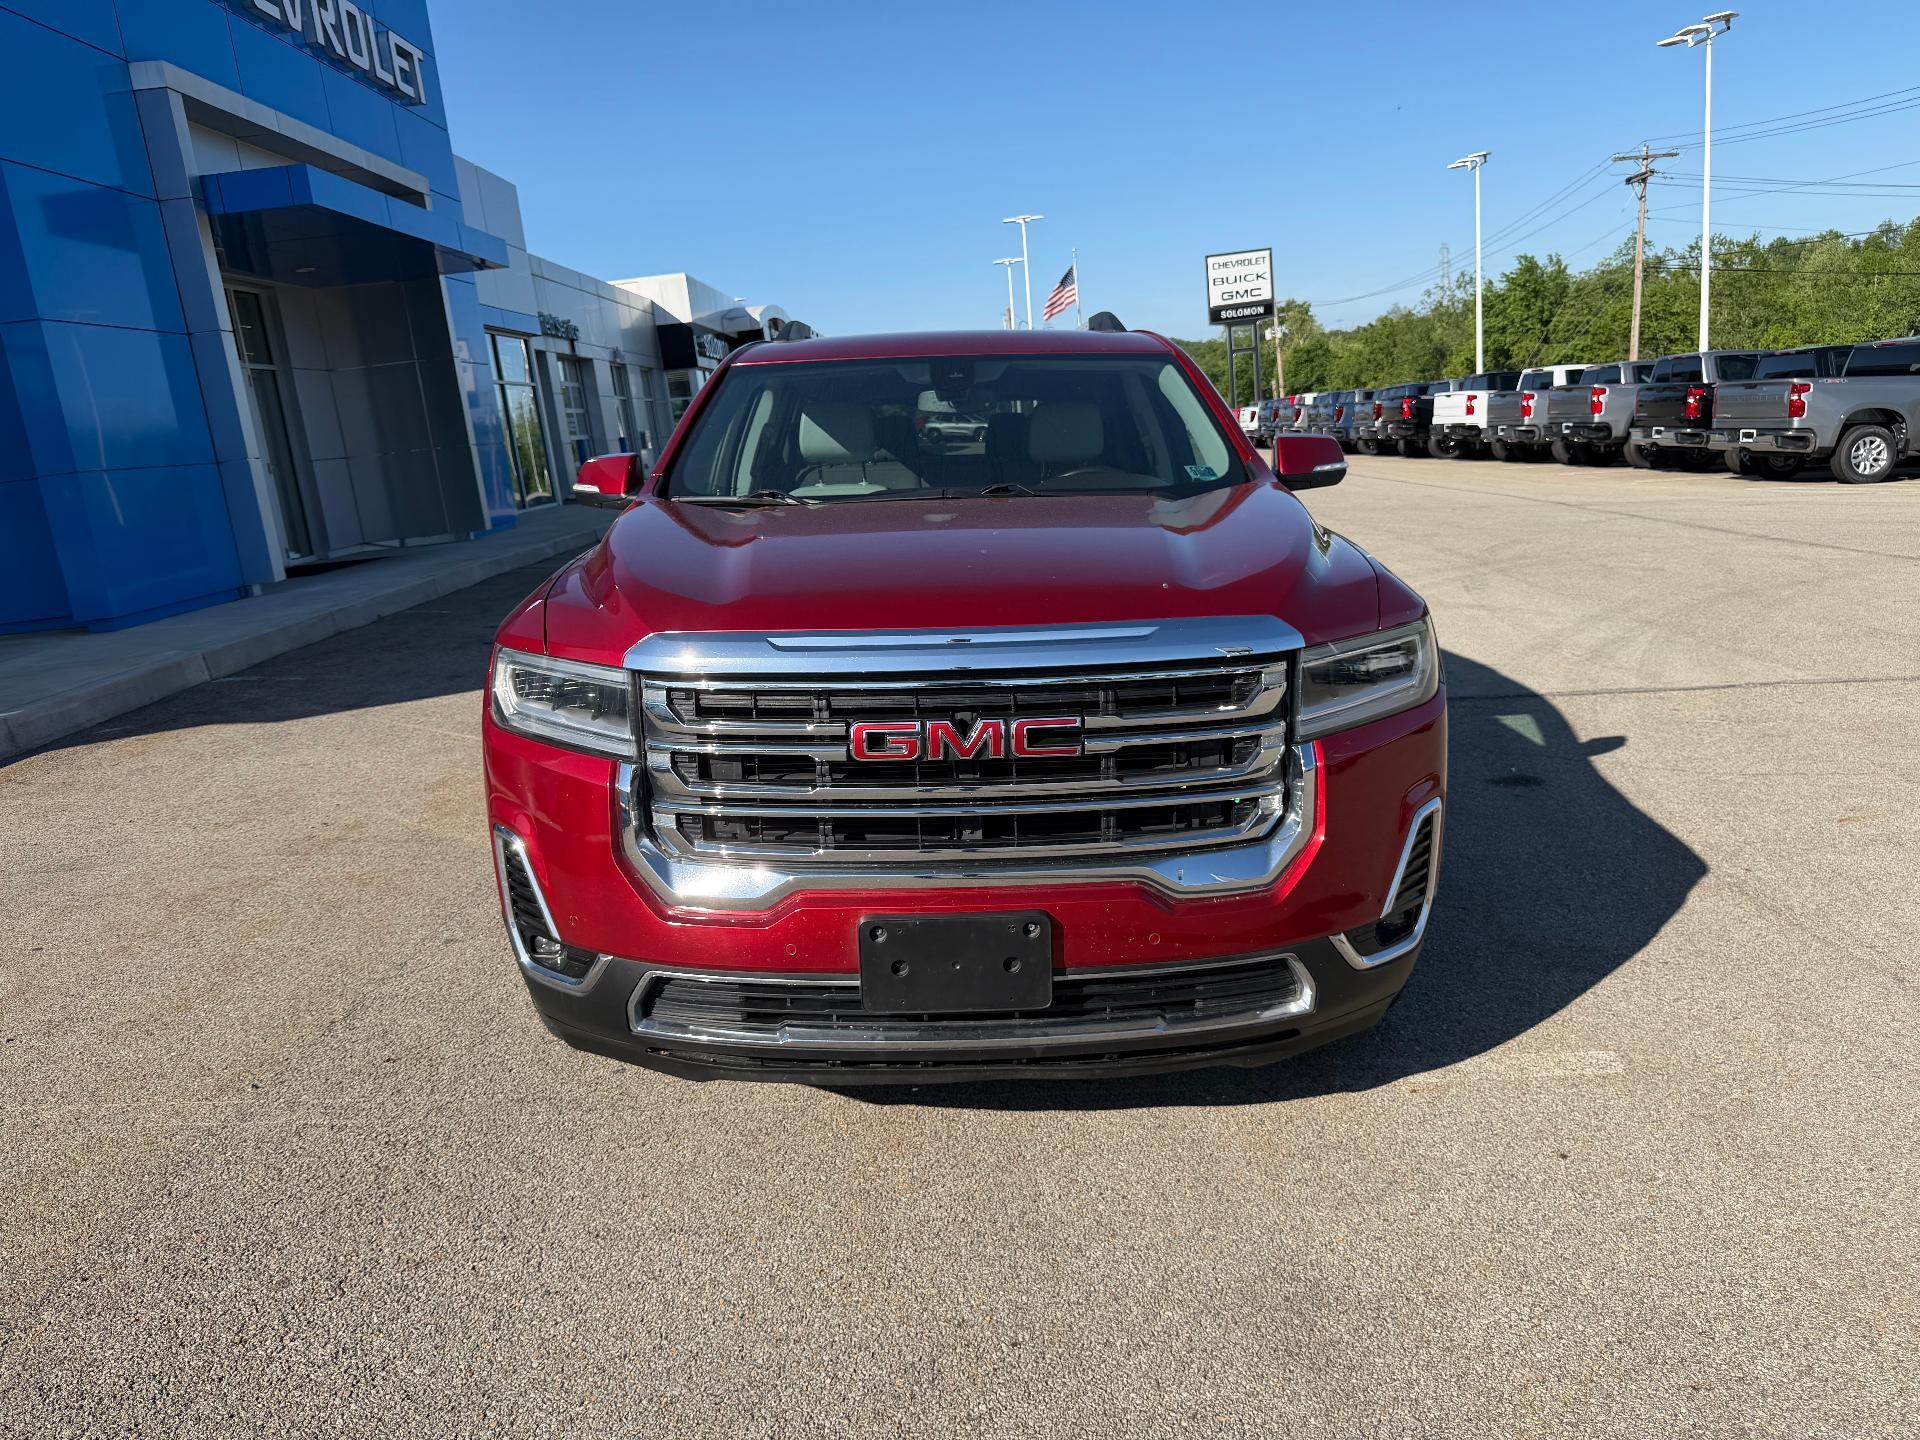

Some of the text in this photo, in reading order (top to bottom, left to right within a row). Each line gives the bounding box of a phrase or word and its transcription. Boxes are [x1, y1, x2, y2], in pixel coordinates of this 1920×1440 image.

[254, 0, 426, 104] VROLET
[1212, 256, 1266, 270] CHEVROLET
[1213, 272, 1268, 286] BUICK
[1221, 288, 1262, 301] GMC
[1220, 306, 1265, 319] SOLOMON
[850, 717, 1082, 761] GMC
